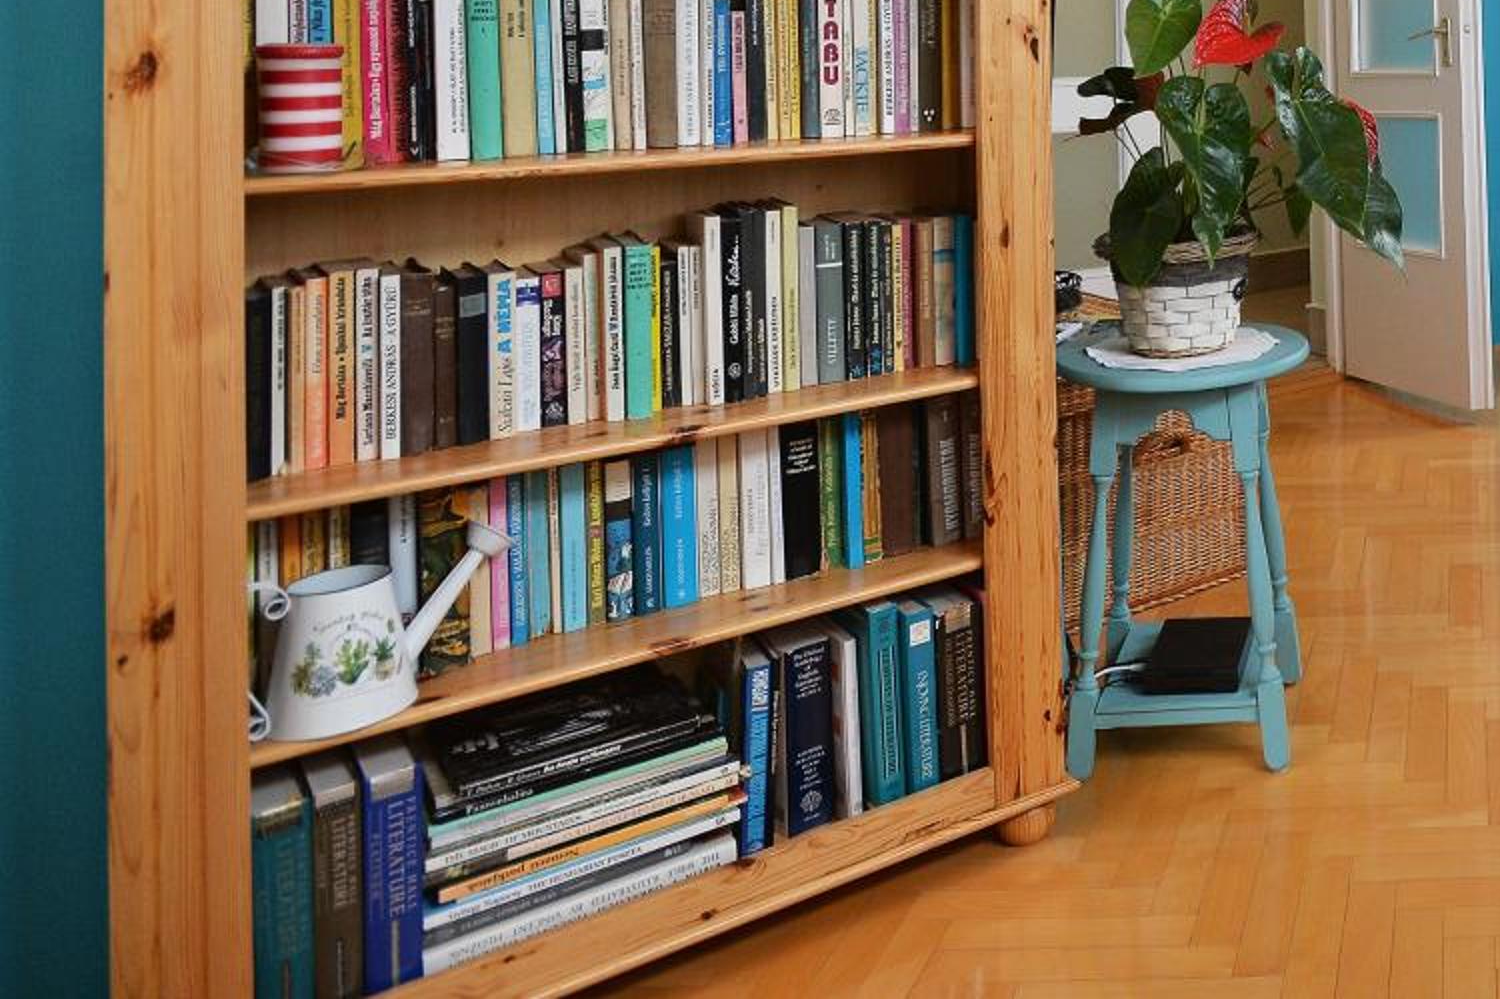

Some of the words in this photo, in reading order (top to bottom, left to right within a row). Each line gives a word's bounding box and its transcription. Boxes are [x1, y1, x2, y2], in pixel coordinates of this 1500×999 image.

[855, 45, 869, 115] JACKIE
[385, 328, 396, 336] A
[497, 338, 513, 354] A
[385, 344, 396, 390] ANDRÁS
[385, 392, 395, 440] BERKESI
[956, 630, 969, 725] LITERATURE
[333, 815, 350, 911] LITERATURE
[389, 800, 407, 919] LITERATURE
[702, 851, 720, 866] THE
